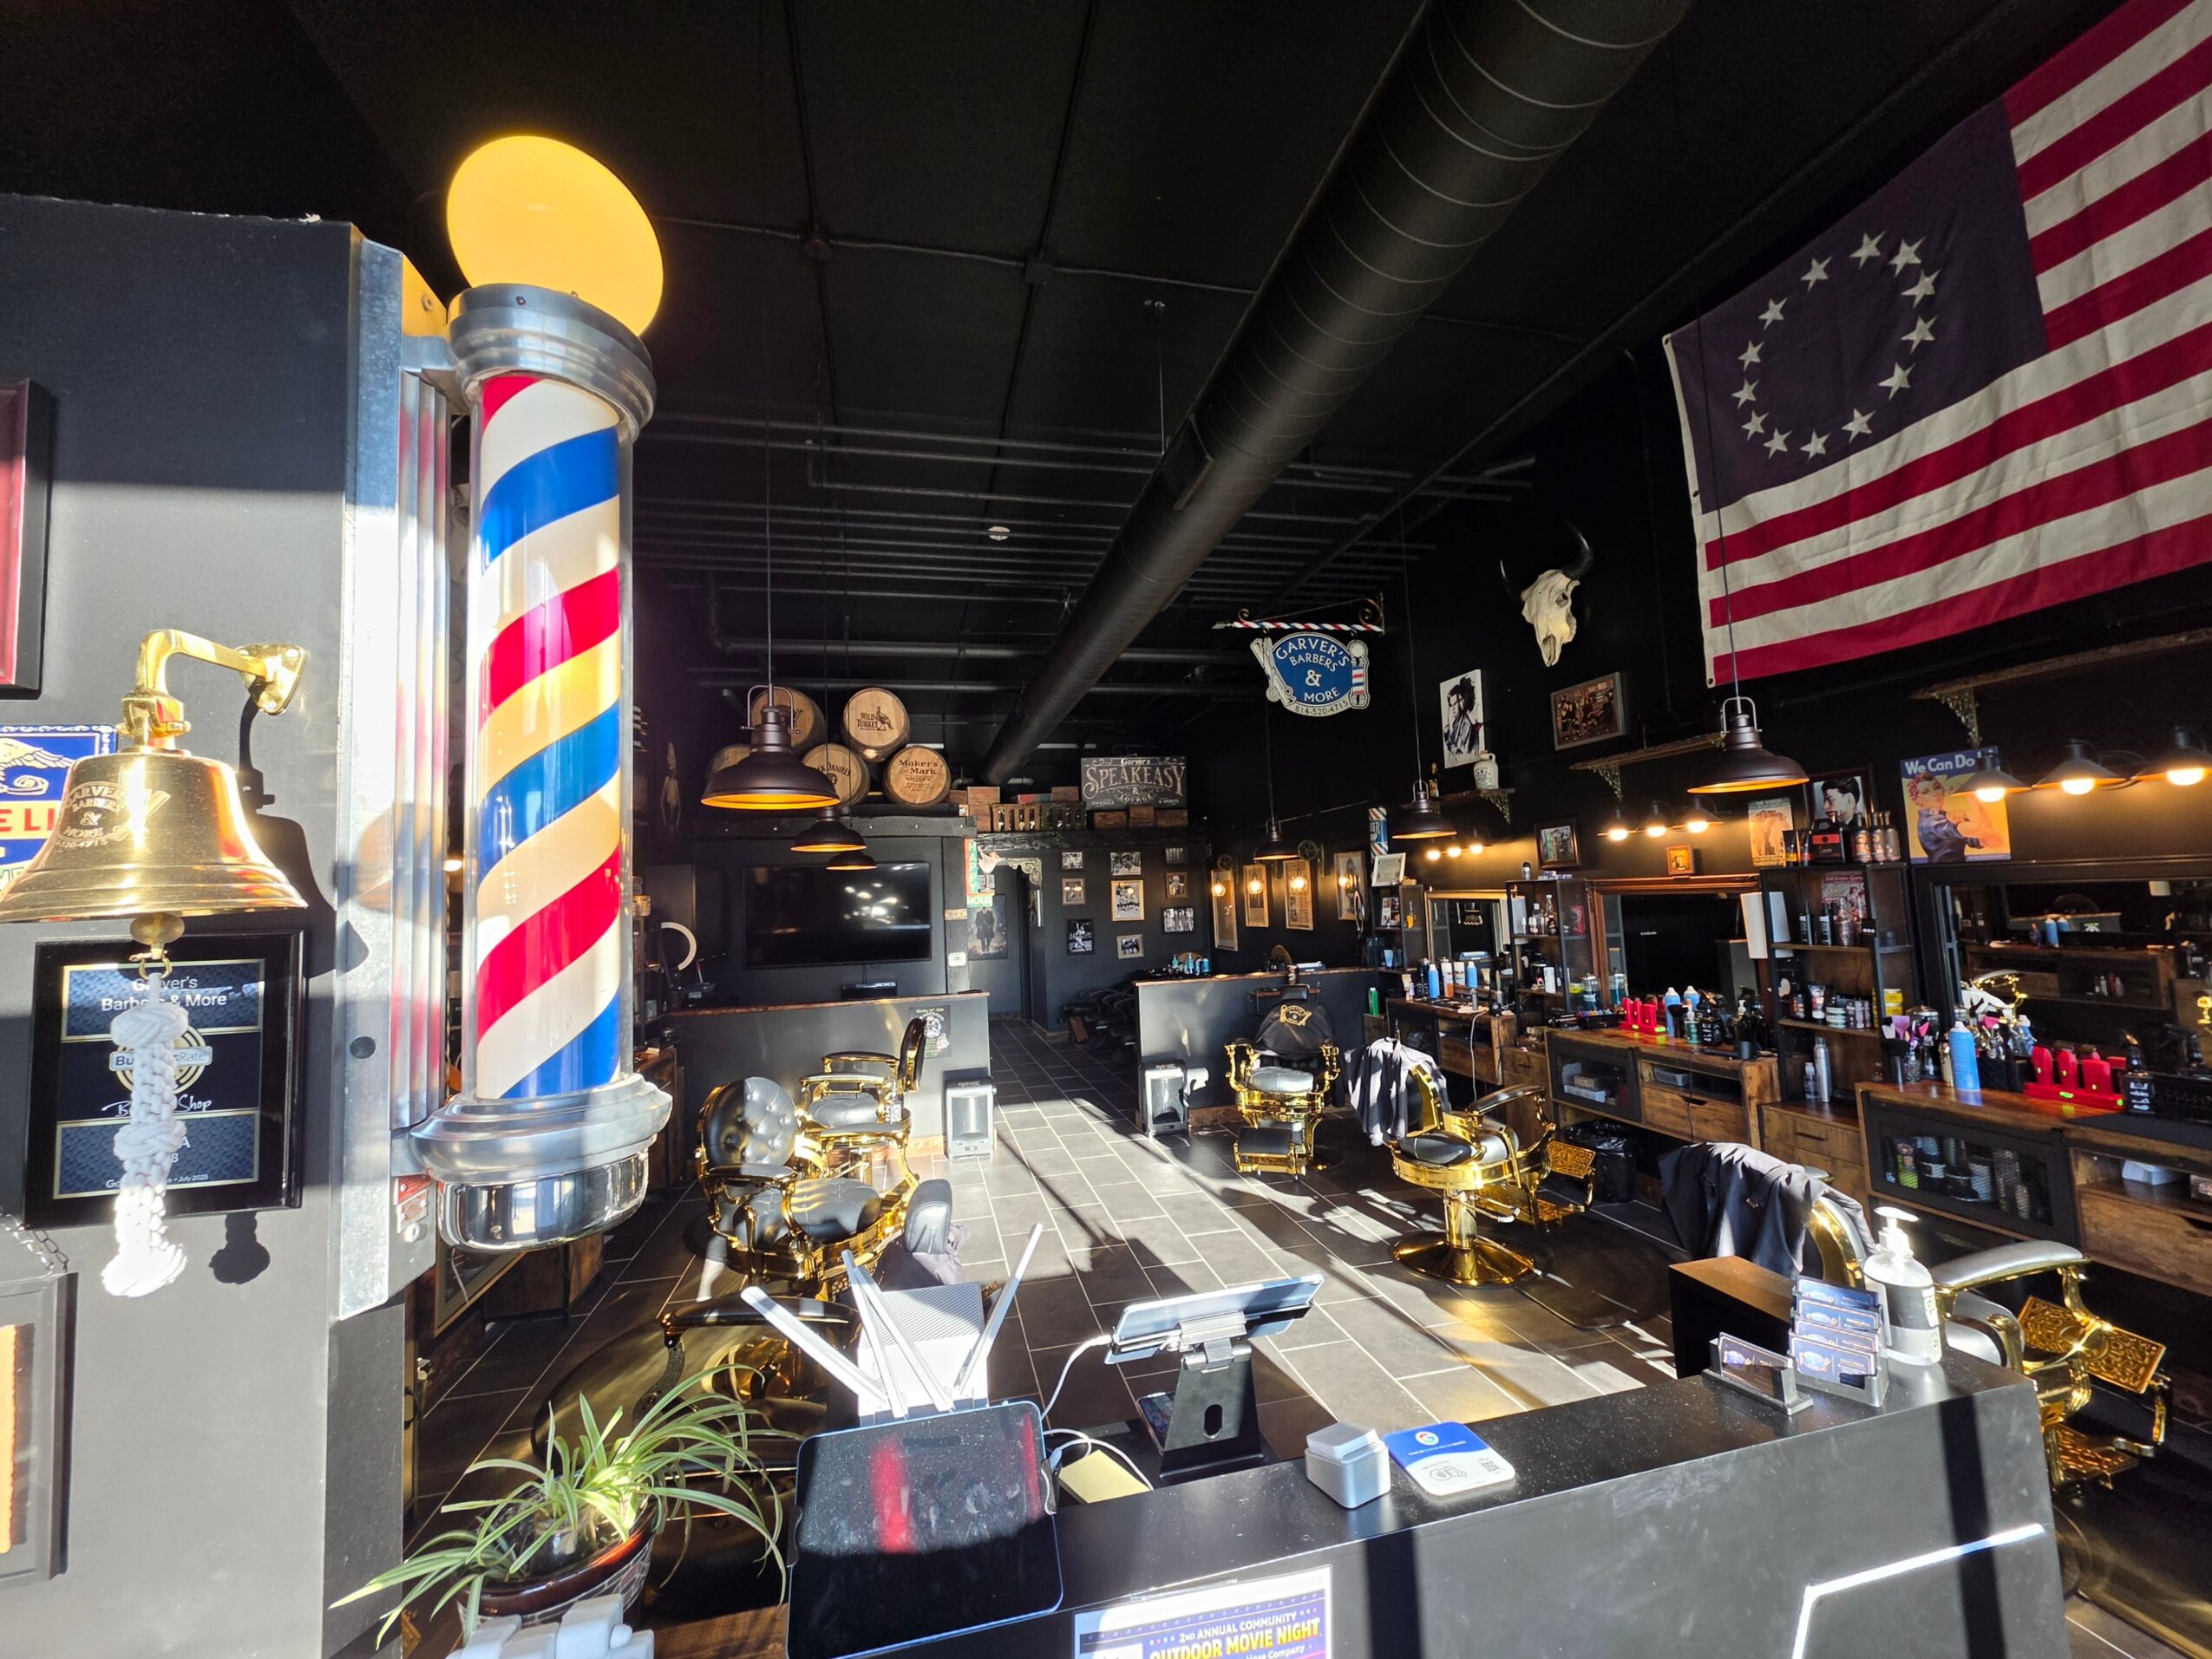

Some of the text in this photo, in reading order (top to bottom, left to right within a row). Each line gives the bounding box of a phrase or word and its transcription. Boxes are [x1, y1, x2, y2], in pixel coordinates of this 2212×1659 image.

[1275, 637, 1350, 667] GARVER'S
[1289, 652, 1338, 672] BARBERS
[1305, 669, 1322, 687] &
[1304, 687, 1340, 702] MORE
[1294, 699, 1350, 715] 814-520-4715
[856, 719, 878, 728] TURKEY
[910, 767, 938, 775] Mark
[1905, 761, 1926, 775] We
[1927, 758, 1953, 772] Can
[1954, 754, 1976, 768] Do
[1083, 765, 1186, 799] SPEAKEASY
[1131, 786, 1140, 795] &
[80, 811, 102, 826] &
[62, 826, 104, 839] MORE
[969, 841, 978, 892] HAPPY
[967, 895, 992, 907] HOUR
[132, 976, 198, 991] Gaver's
[186, 993, 227, 1007] More
[178, 1094, 213, 1113] Shop
[1178, 1610, 1297, 1643] 2ND ANNUAL COMMUNITY
[1226, 1631, 1273, 1655] MOVIE
[1276, 1617, 1320, 1644] NIGHT
[1268, 1644, 1306, 1659] Company
